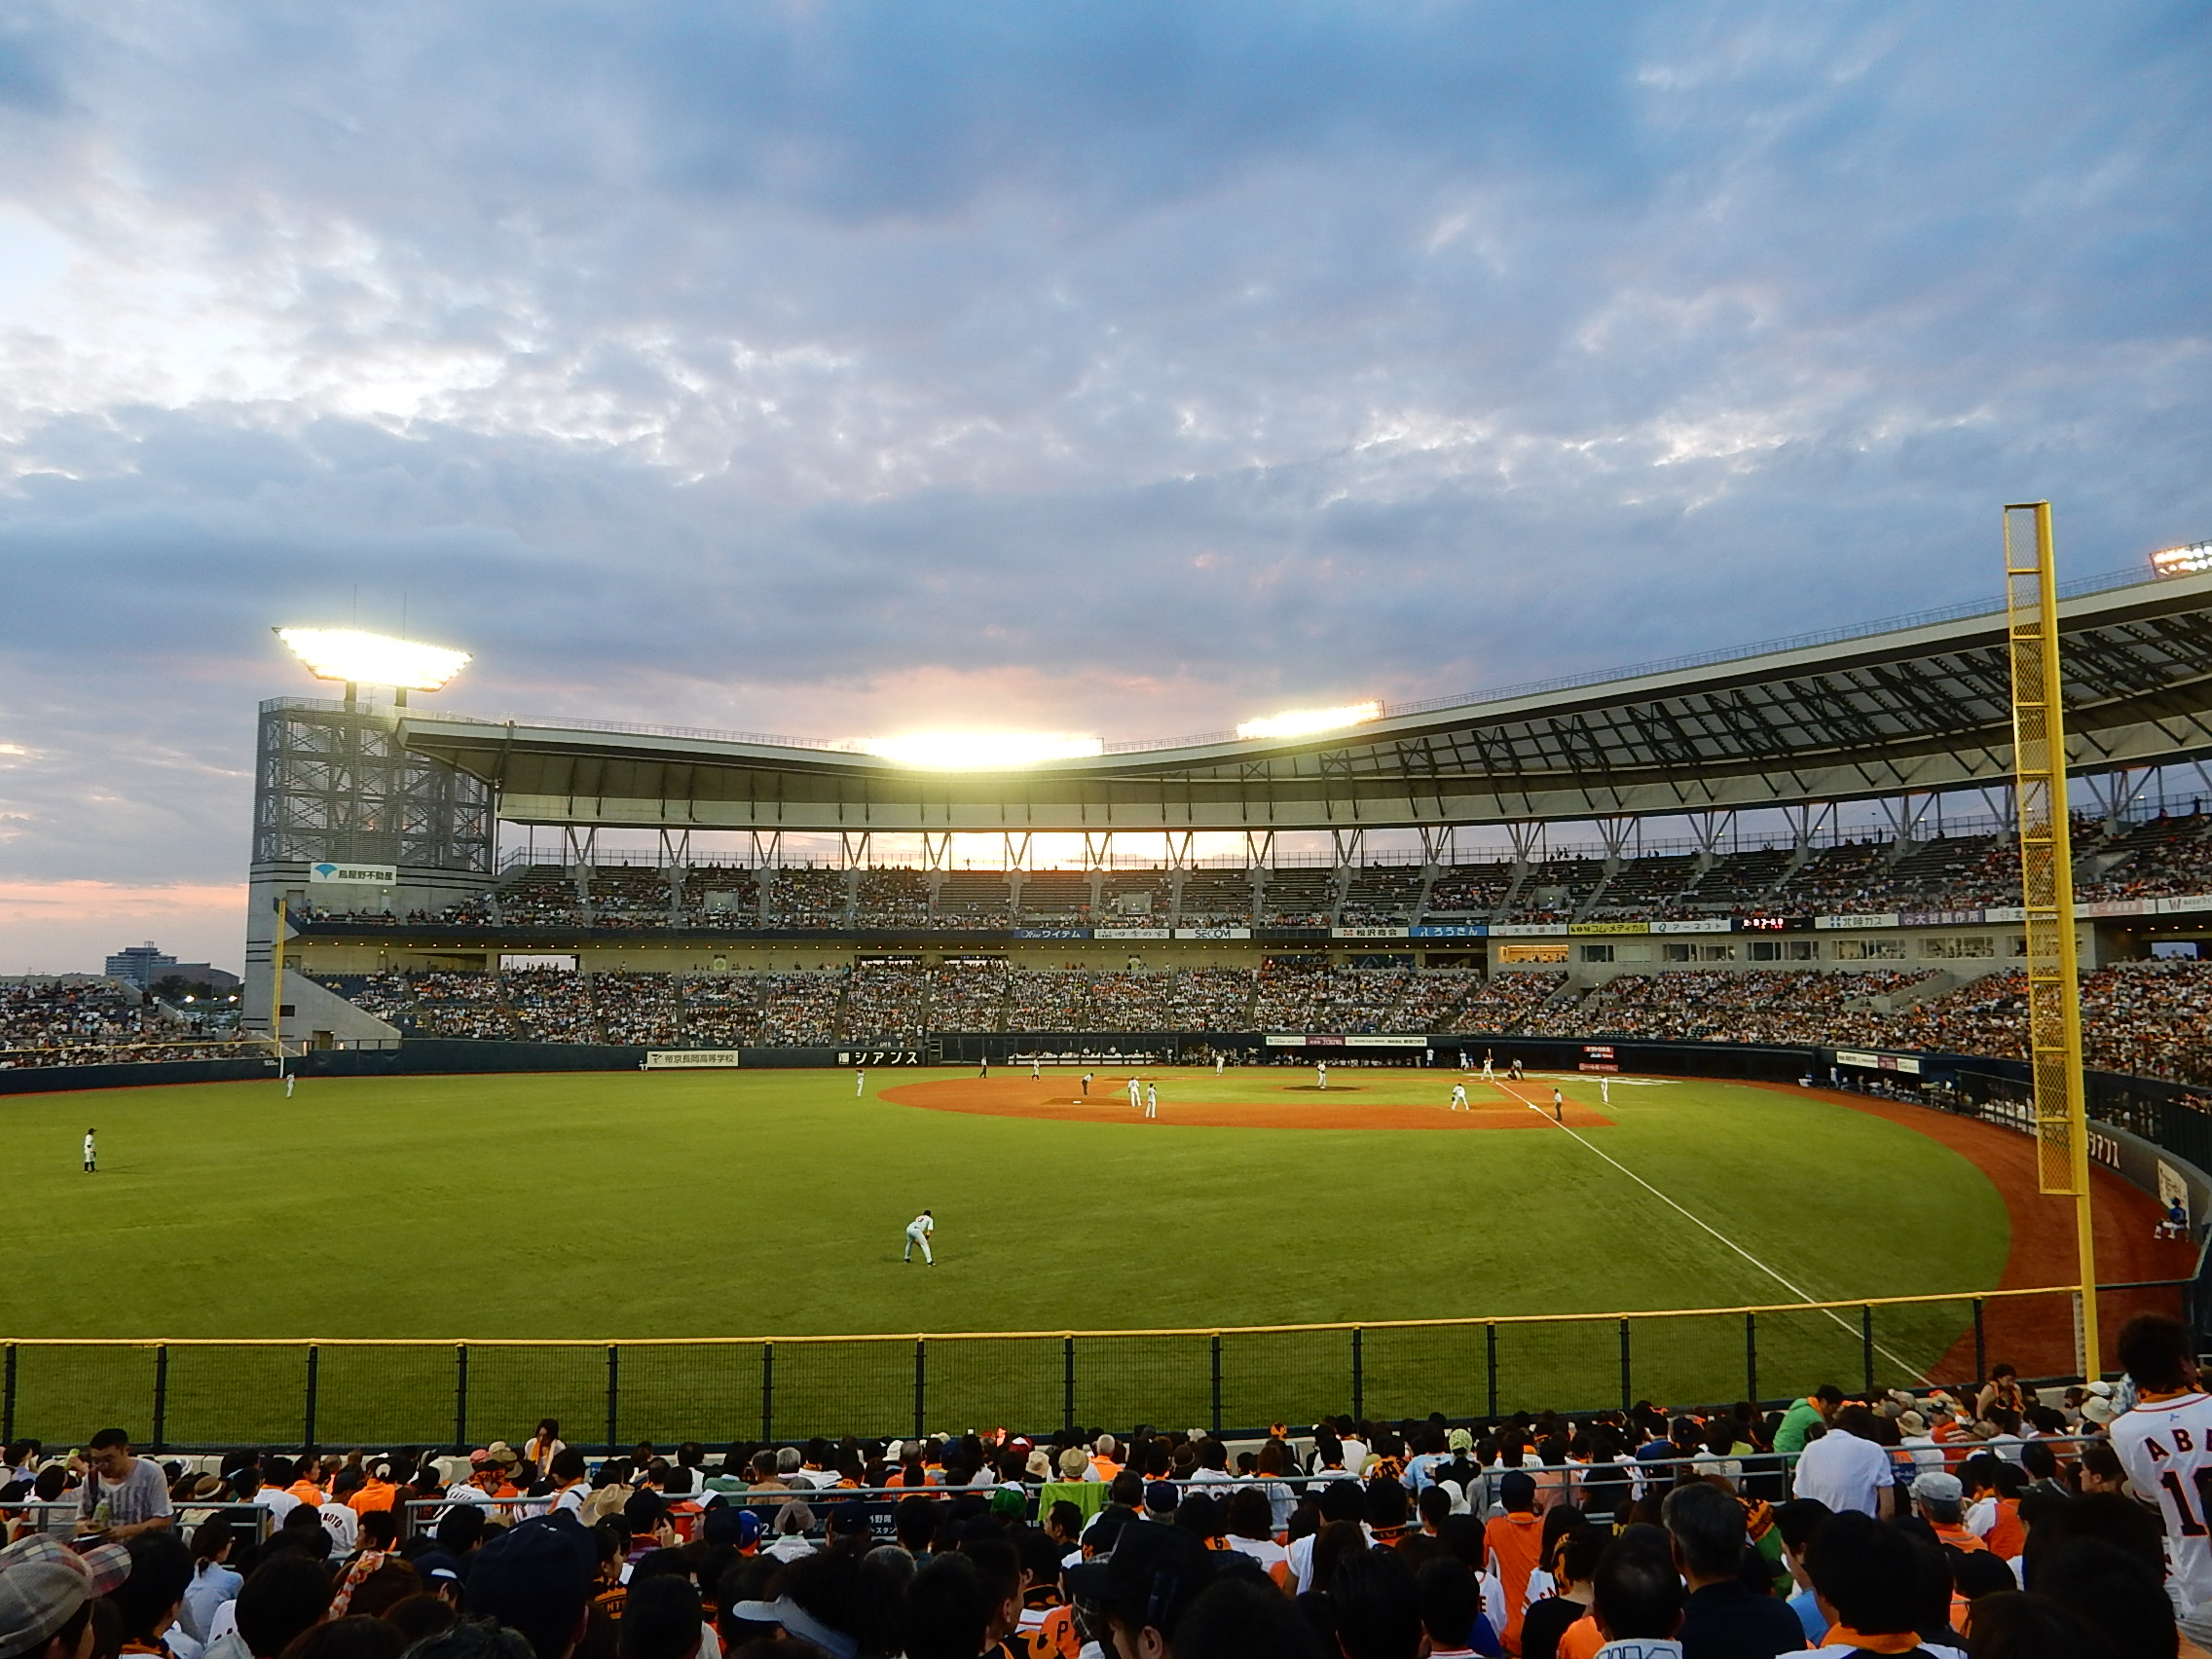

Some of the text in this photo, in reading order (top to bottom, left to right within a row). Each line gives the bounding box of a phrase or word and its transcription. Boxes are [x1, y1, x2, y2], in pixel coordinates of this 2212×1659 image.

[1842, 916, 1882, 927] 北陸ガス
[1915, 910, 1980, 925] 大谷製作所
[1042, 930, 1081, 939] ワイテム
[1195, 929, 1231, 939] SECOM
[1356, 928, 1397, 937] 松沢商会
[1433, 927, 1478, 937] ろうきん
[664, 1053, 734, 1063] 帝京長岡高等学校
[855, 1051, 918, 1065] シアンス
